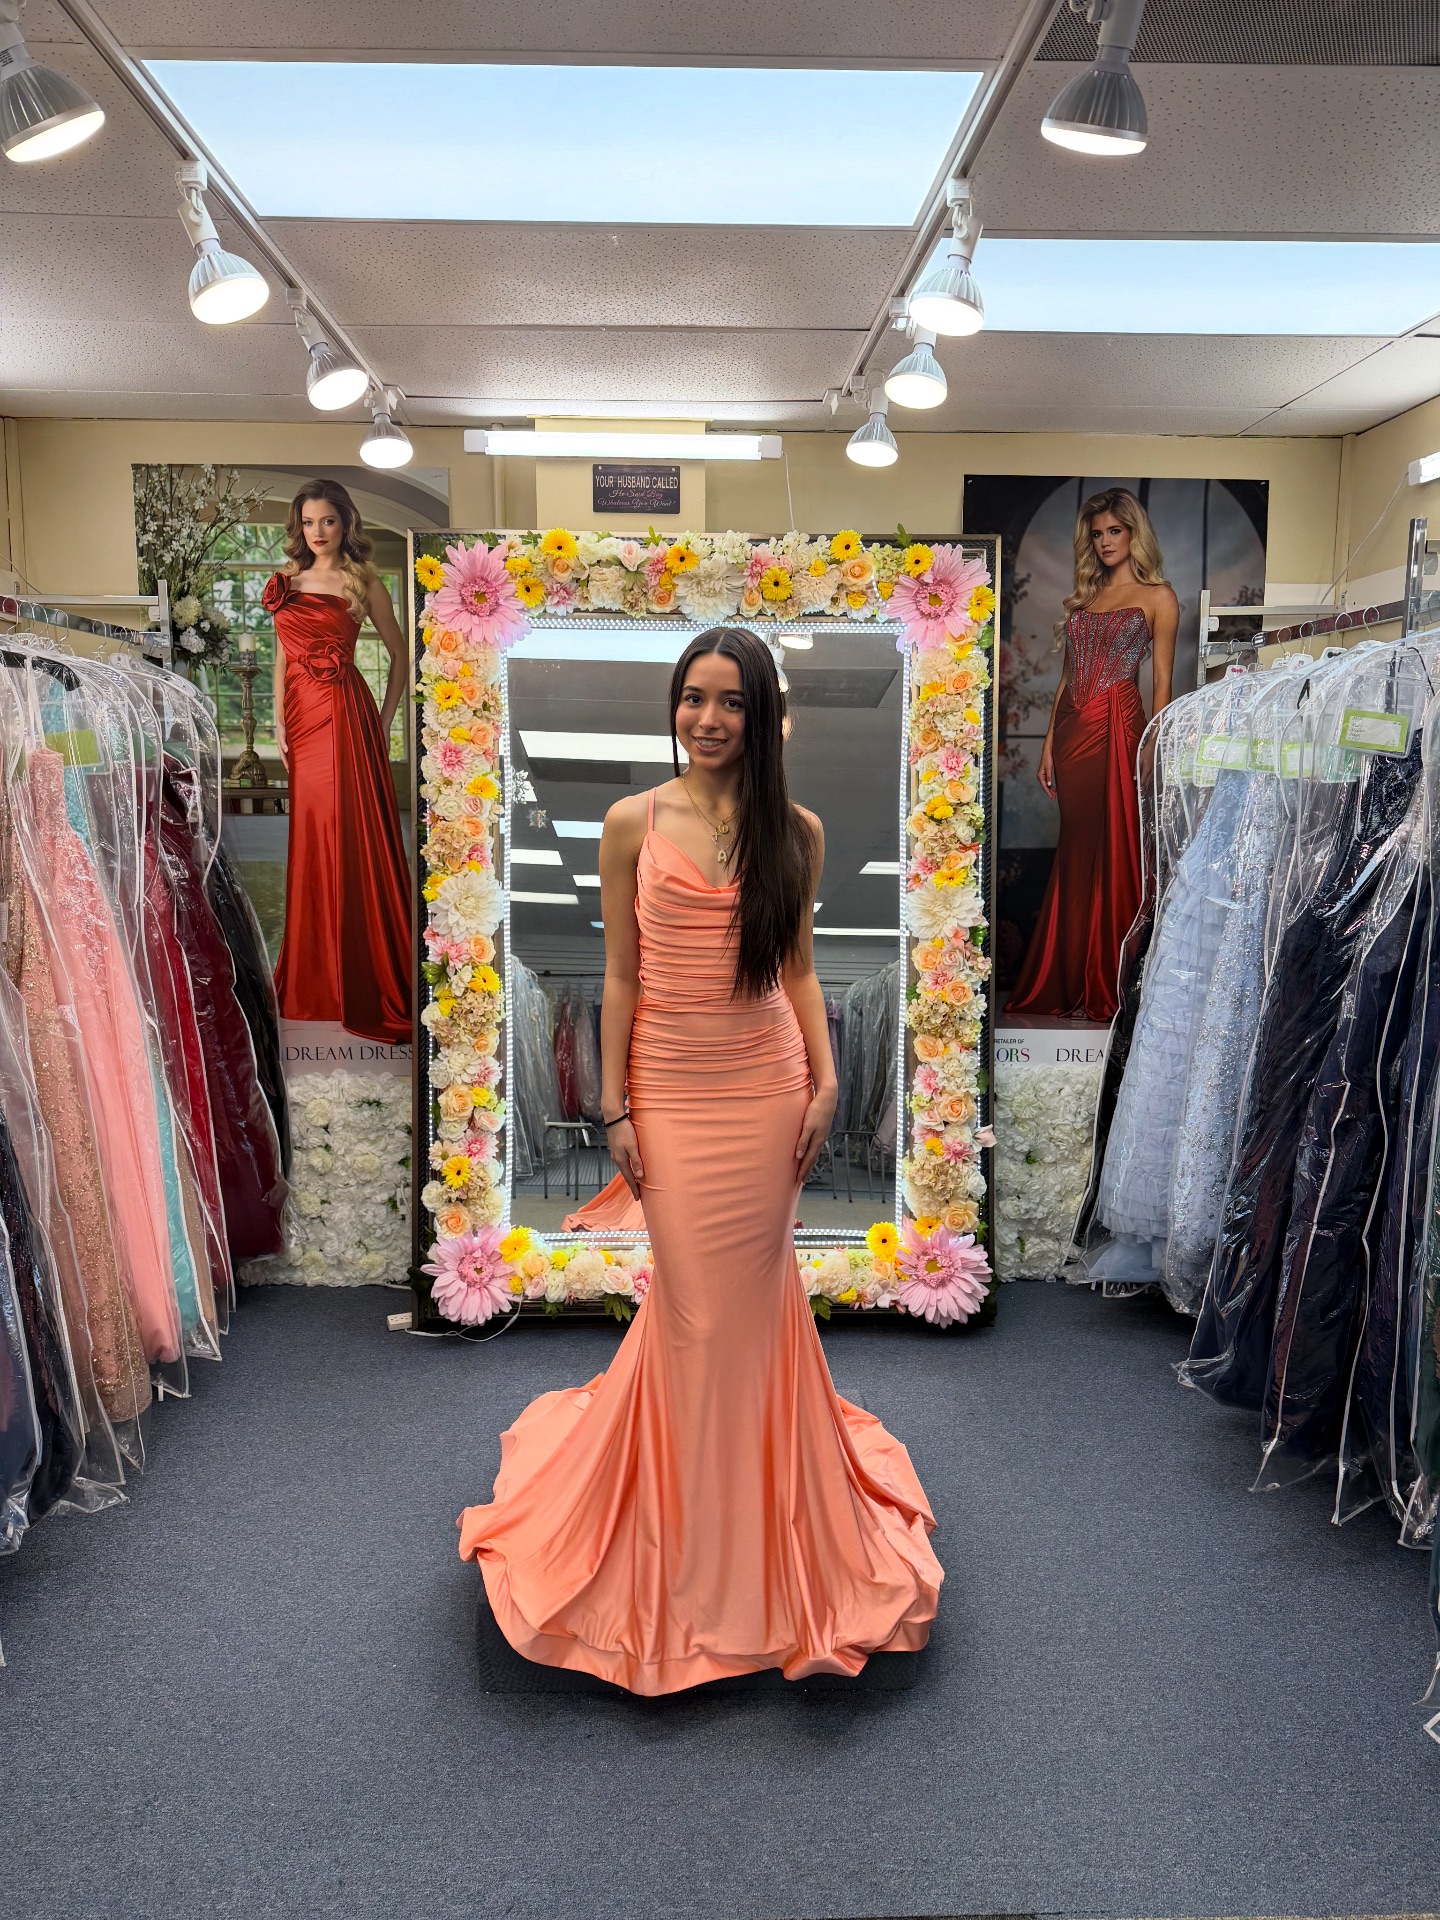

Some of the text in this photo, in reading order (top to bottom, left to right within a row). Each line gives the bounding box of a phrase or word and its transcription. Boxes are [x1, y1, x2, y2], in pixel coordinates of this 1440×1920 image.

[595, 475, 679, 489] YOUR HUSBAND CALLED
[608, 489, 626, 498] He
[626, 489, 645, 498] Said
[631, 497, 648, 508] You
[285, 1046, 353, 1061] DREAM
[994, 1047, 1031, 1063] ORS
